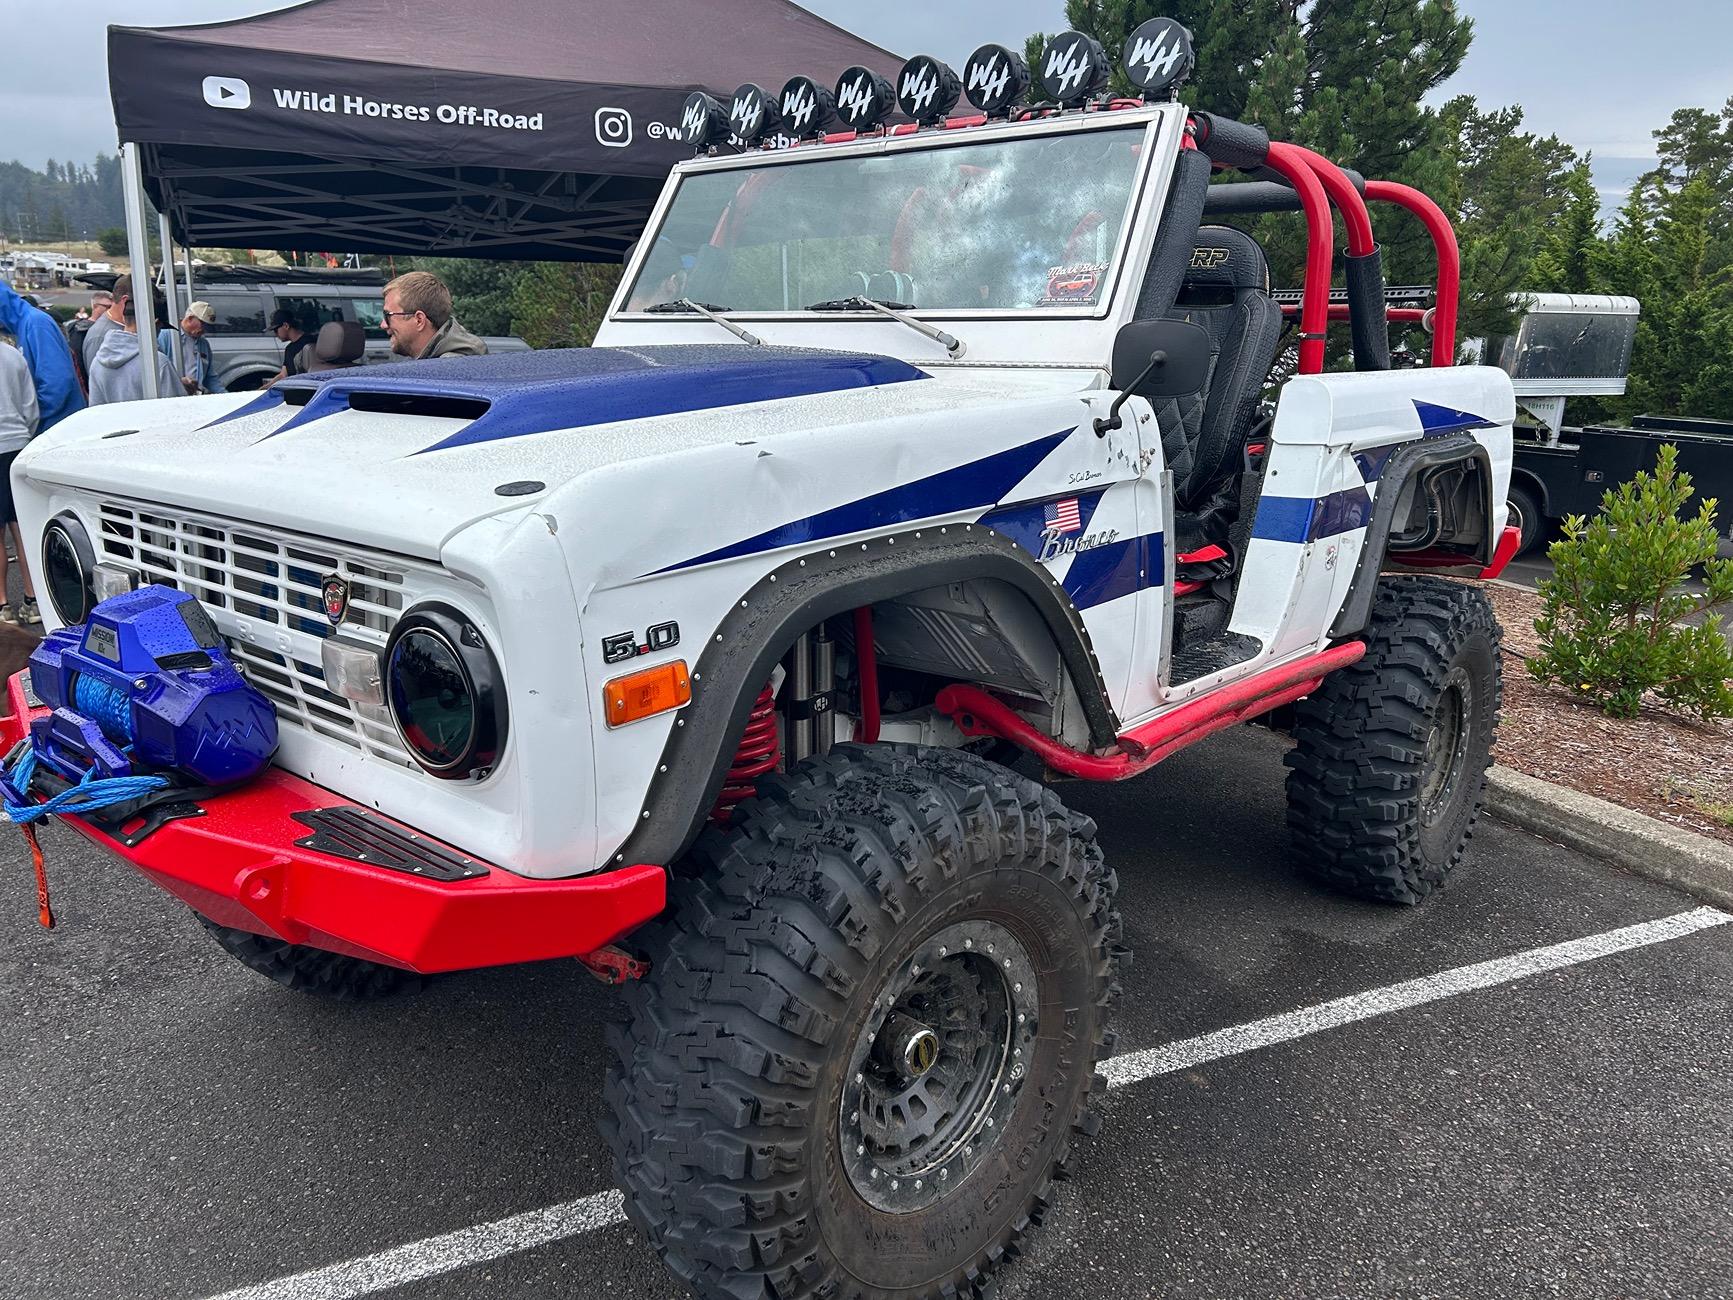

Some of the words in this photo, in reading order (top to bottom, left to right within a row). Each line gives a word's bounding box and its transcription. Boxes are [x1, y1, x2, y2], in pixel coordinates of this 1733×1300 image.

[1045, 38, 1090, 95] WH
[1128, 25, 1183, 84] WH
[838, 72, 874, 123] WH
[901, 62, 939, 114] WH
[968, 51, 1011, 106] WH
[273, 89, 336, 113] Wild
[343, 96, 430, 122] Horses
[436, 104, 543, 131] Off-Road
[681, 99, 706, 140] WH
[731, 90, 762, 133] WH
[782, 82, 816, 129] WH
[1190, 247, 1230, 269] RP
[1034, 527, 1119, 563] Bronco
[601, 620, 680, 664] 5.0
